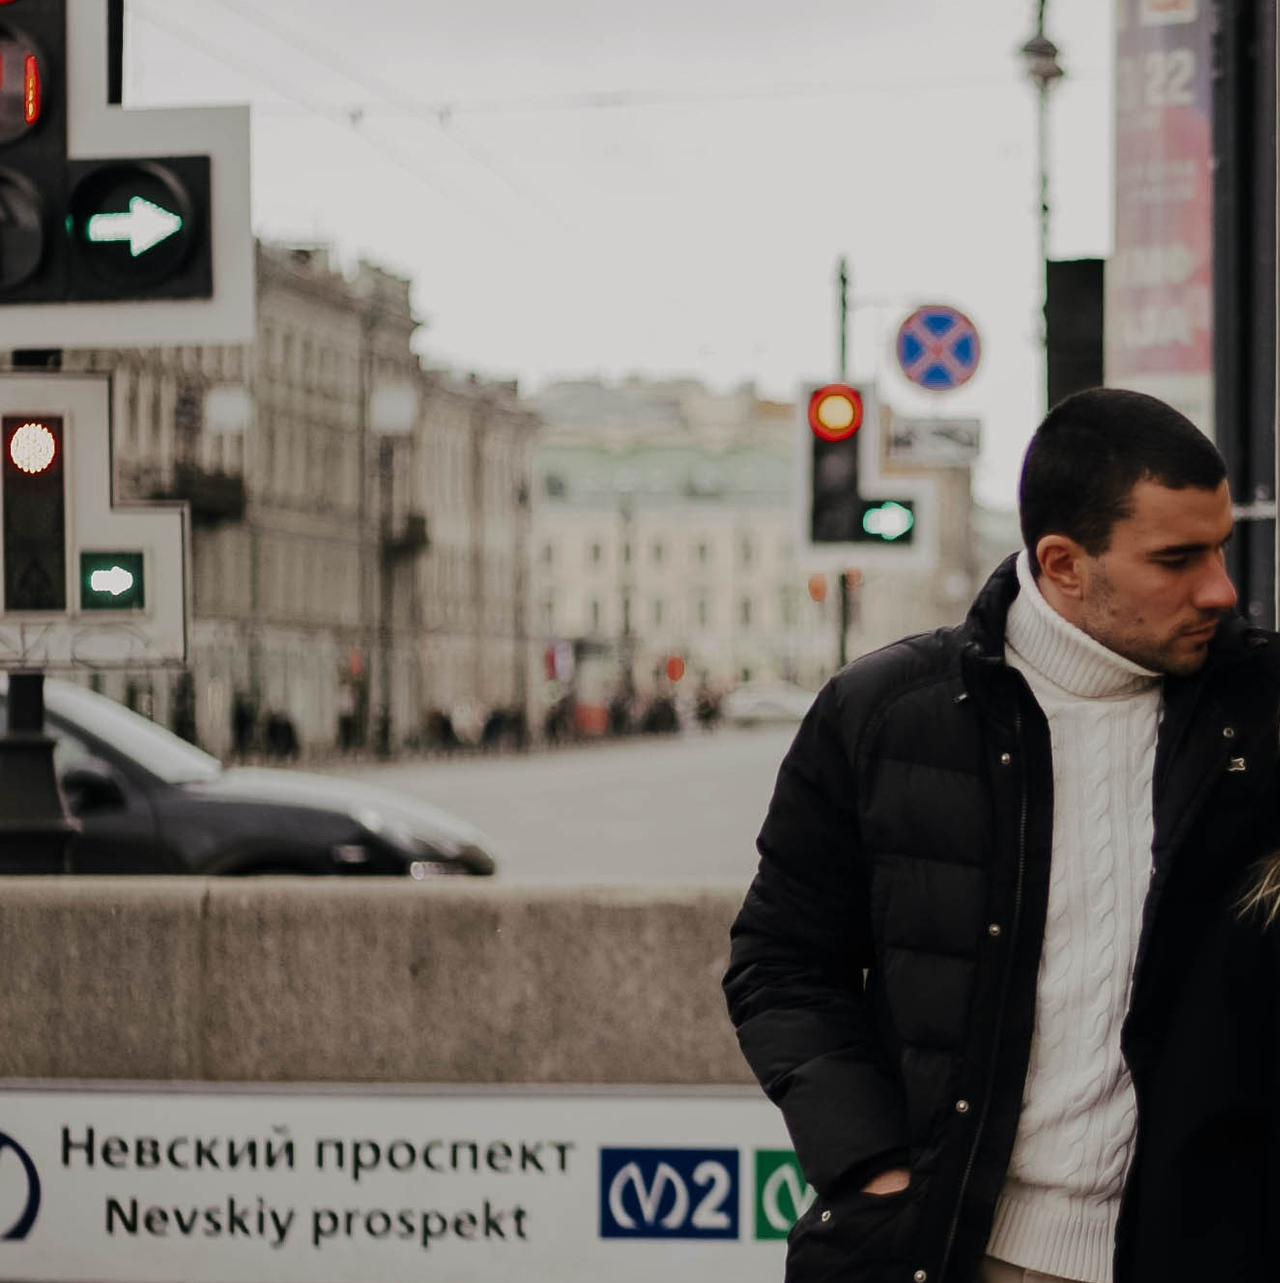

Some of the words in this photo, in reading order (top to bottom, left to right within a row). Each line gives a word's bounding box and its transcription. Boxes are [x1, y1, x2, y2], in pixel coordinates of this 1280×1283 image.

[61, 1125, 295, 1170] Невский
[316, 1137, 575, 1184] проспект
[106, 1195, 295, 1250] Nevskiy
[311, 1197, 529, 1251] prospekt
